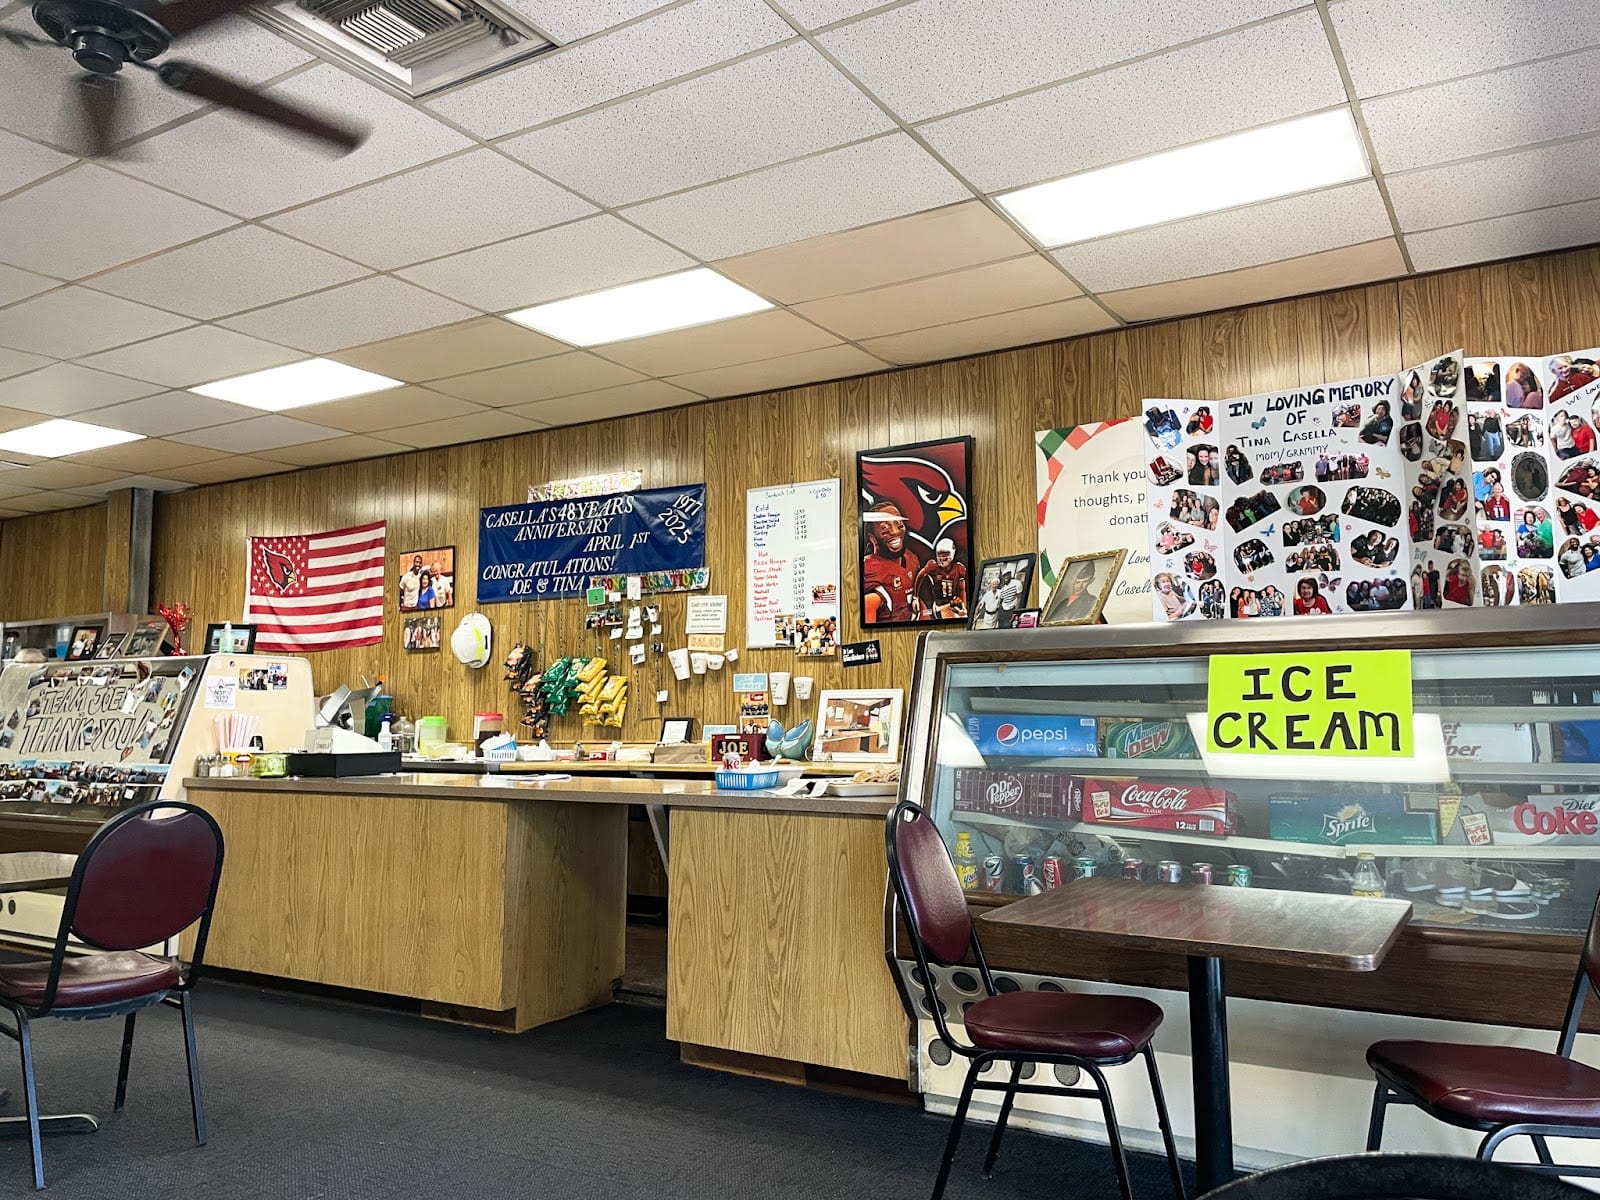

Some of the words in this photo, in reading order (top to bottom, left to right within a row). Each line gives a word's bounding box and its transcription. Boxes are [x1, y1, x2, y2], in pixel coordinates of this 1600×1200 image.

[1229, 401, 1253, 417] IN
[1266, 389, 1325, 412] LOVING
[1329, 378, 1395, 402] MEMORY
[1566, 394, 1581, 405] WE
[1286, 410, 1307, 426] OF
[1236, 436, 1271, 448] TINA
[1283, 428, 1337, 443] CASELLA
[1081, 470, 1120, 485] Thank
[1123, 470, 1146, 484] you
[673, 494, 703, 516] 1977
[755, 503, 769, 513] Cold
[1074, 493, 1133, 508] thoughts,
[486, 506, 557, 529] CASELLA'S
[558, 503, 576, 522] 48
[575, 496, 635, 520] YEARS
[1109, 512, 1149, 526] donati
[514, 517, 614, 542] ANNIVERSARY
[657, 507, 694, 545] 2025
[583, 536, 624, 552] APRIL
[629, 531, 651, 549] 1ST
[483, 556, 616, 580] CONGRATULATIONS!
[509, 579, 533, 595] JOE
[536, 578, 548, 592] &
[553, 575, 585, 592] TINA
[601, 570, 706, 591] CONGTULATIONS
[1116, 580, 1152, 596] Casell
[1242, 665, 1356, 702] ICE
[214, 695, 229, 703] 2022
[19, 717, 93, 754] THANK
[1021, 727, 1068, 743] pepsi
[1213, 710, 1401, 751] CREAM
[1441, 721, 1461, 734] et
[719, 741, 748, 755] JOE
[1446, 745, 1481, 757] per
[988, 784, 1021, 803] Pepper
[1000, 780, 1013, 793] Dr
[1120, 784, 1192, 811] Coca-Cola
[1562, 798, 1596, 811] Diet
[1175, 821, 1186, 829] 12
[1326, 812, 1370, 838] Sprite
[1513, 803, 1598, 835] Coke
